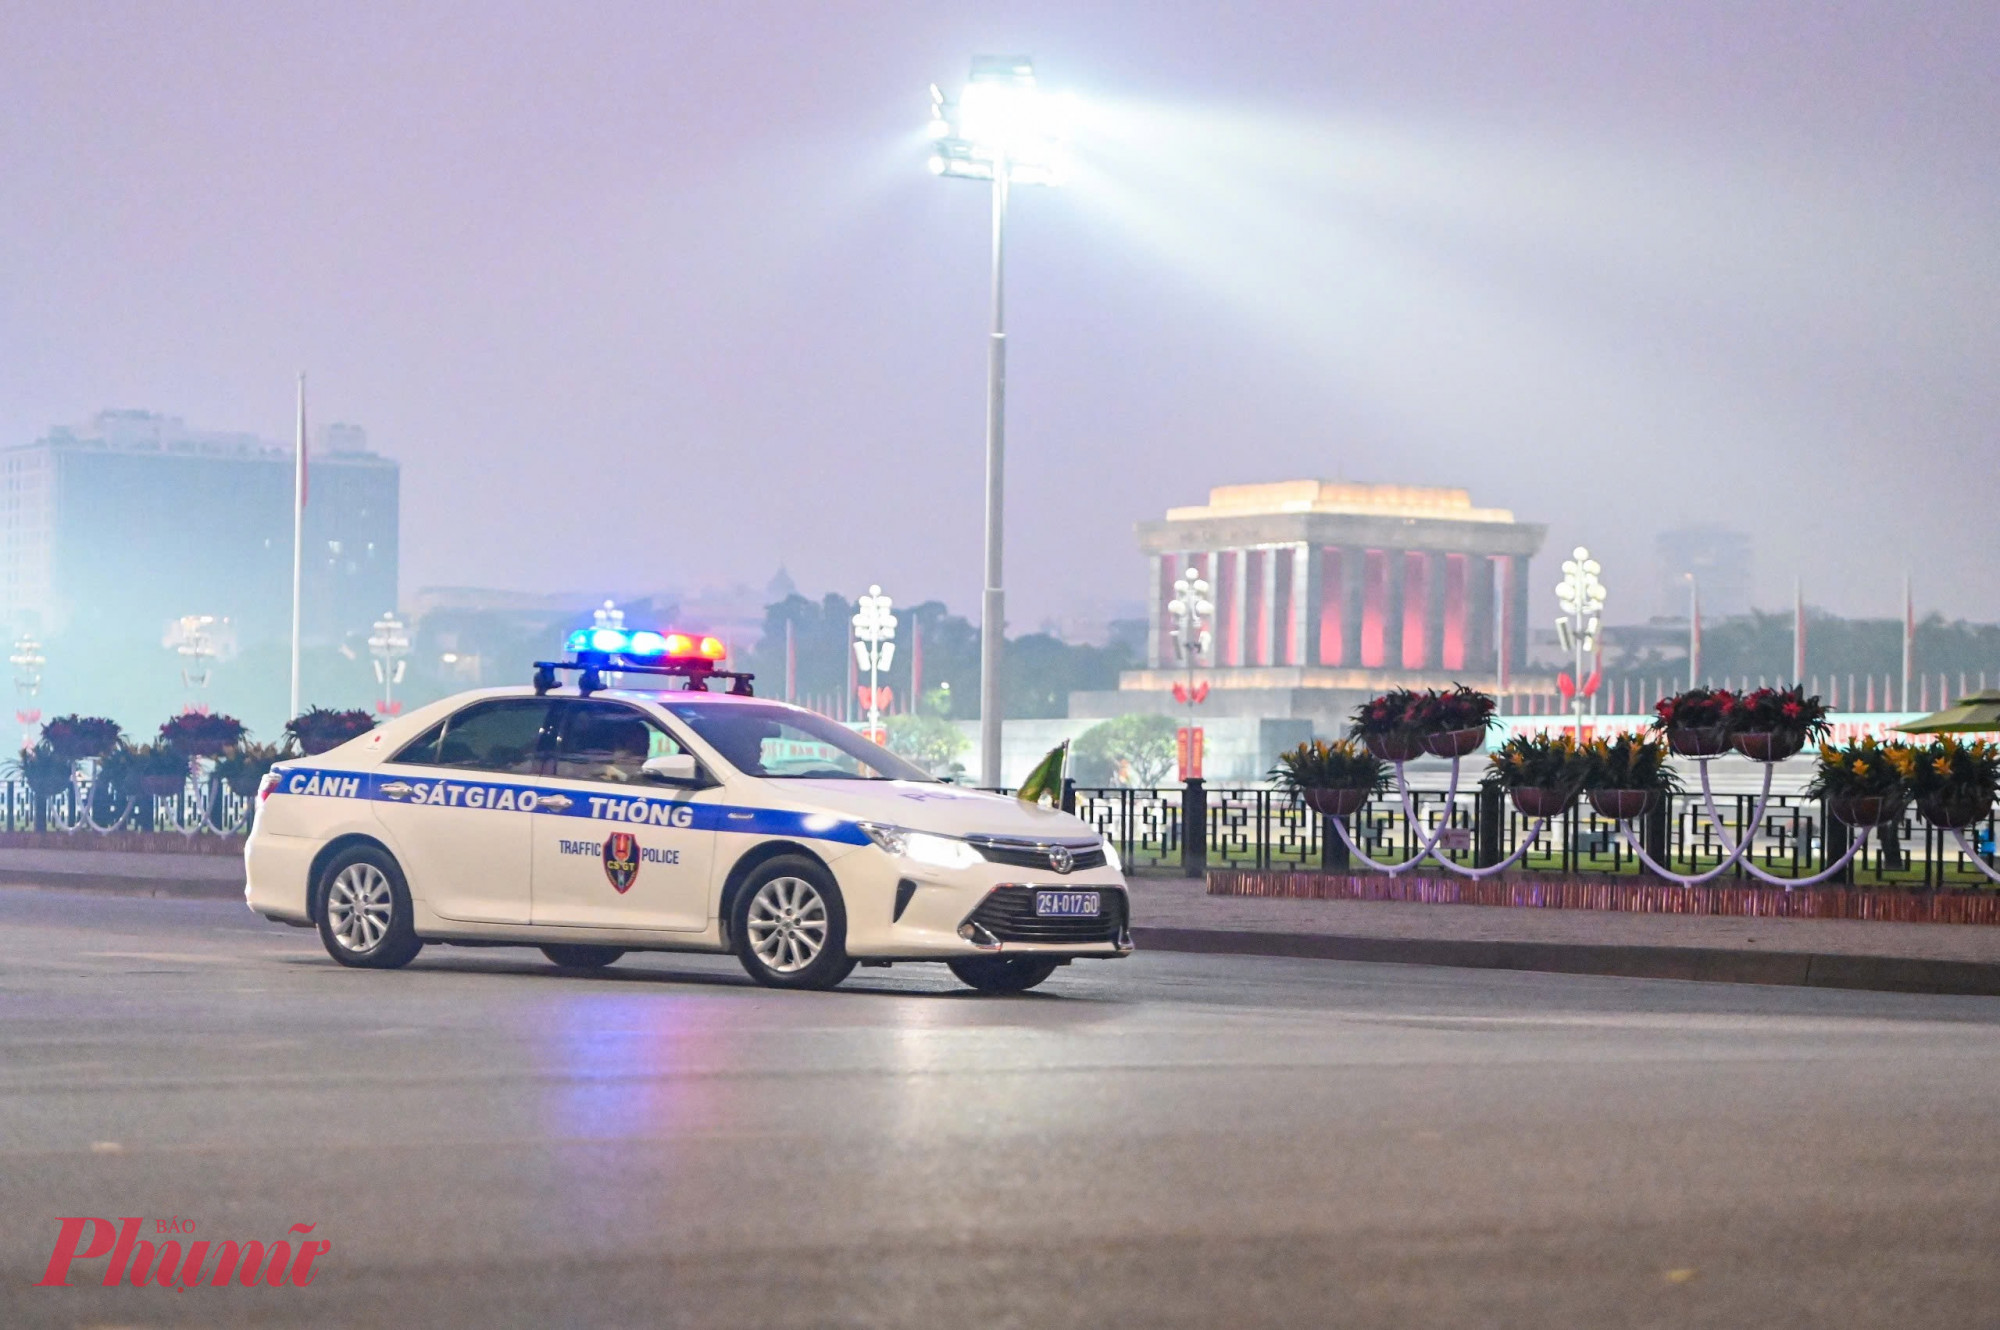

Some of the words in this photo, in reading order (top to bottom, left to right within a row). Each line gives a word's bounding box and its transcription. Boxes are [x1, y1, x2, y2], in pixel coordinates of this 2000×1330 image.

[289, 771, 360, 798] CẢNH
[589, 797, 694, 828] THÔNG
[559, 840, 602, 857] TRAFFIC
[641, 847, 680, 864] POLICE
